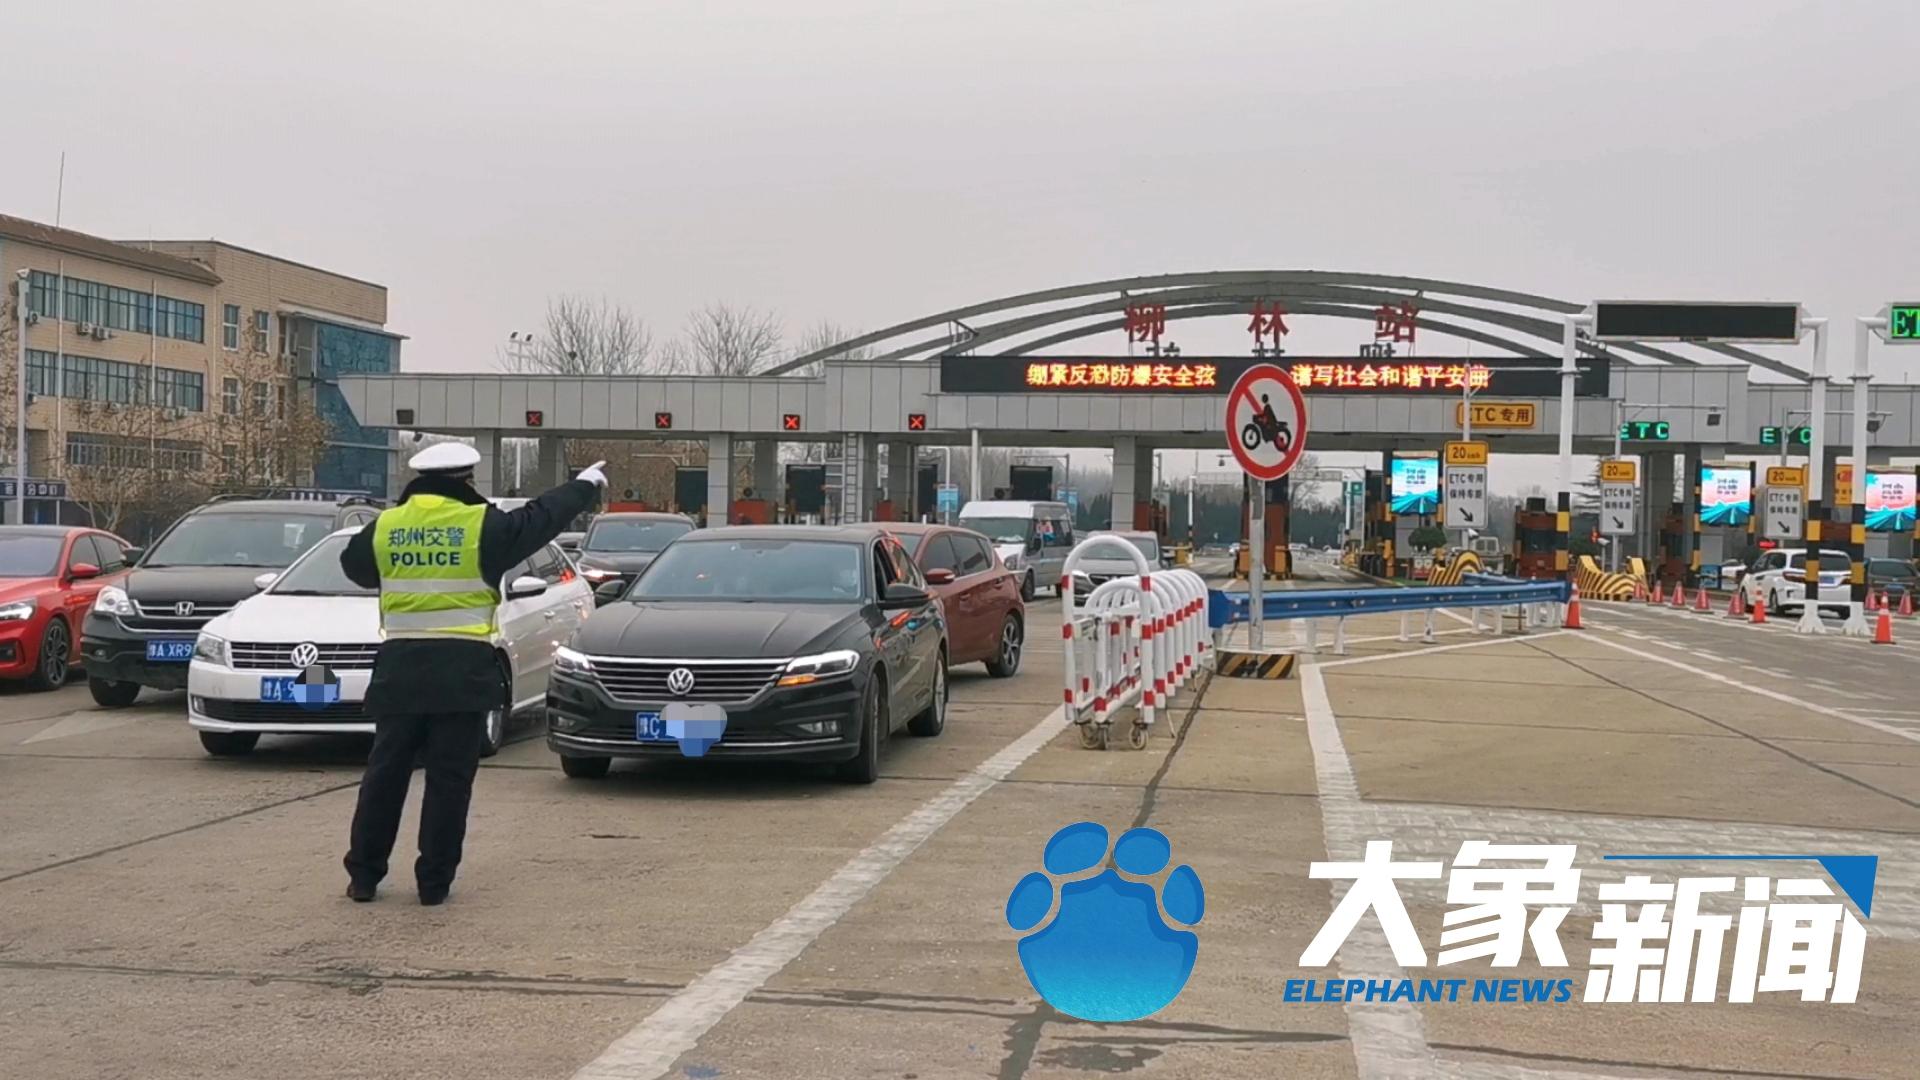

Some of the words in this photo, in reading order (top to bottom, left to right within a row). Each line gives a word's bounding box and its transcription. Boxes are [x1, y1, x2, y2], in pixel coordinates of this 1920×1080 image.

[1124, 300, 1419, 345] 柳林站
[1027, 363, 1216, 387] 绷紧反恐防爆安全弦
[1465, 407, 1495, 422] TC
[1452, 446, 1466, 459] 20
[1606, 464, 1618, 476] 20
[388, 526, 465, 547] 郑州交警
[390, 551, 461, 566] POLICE
